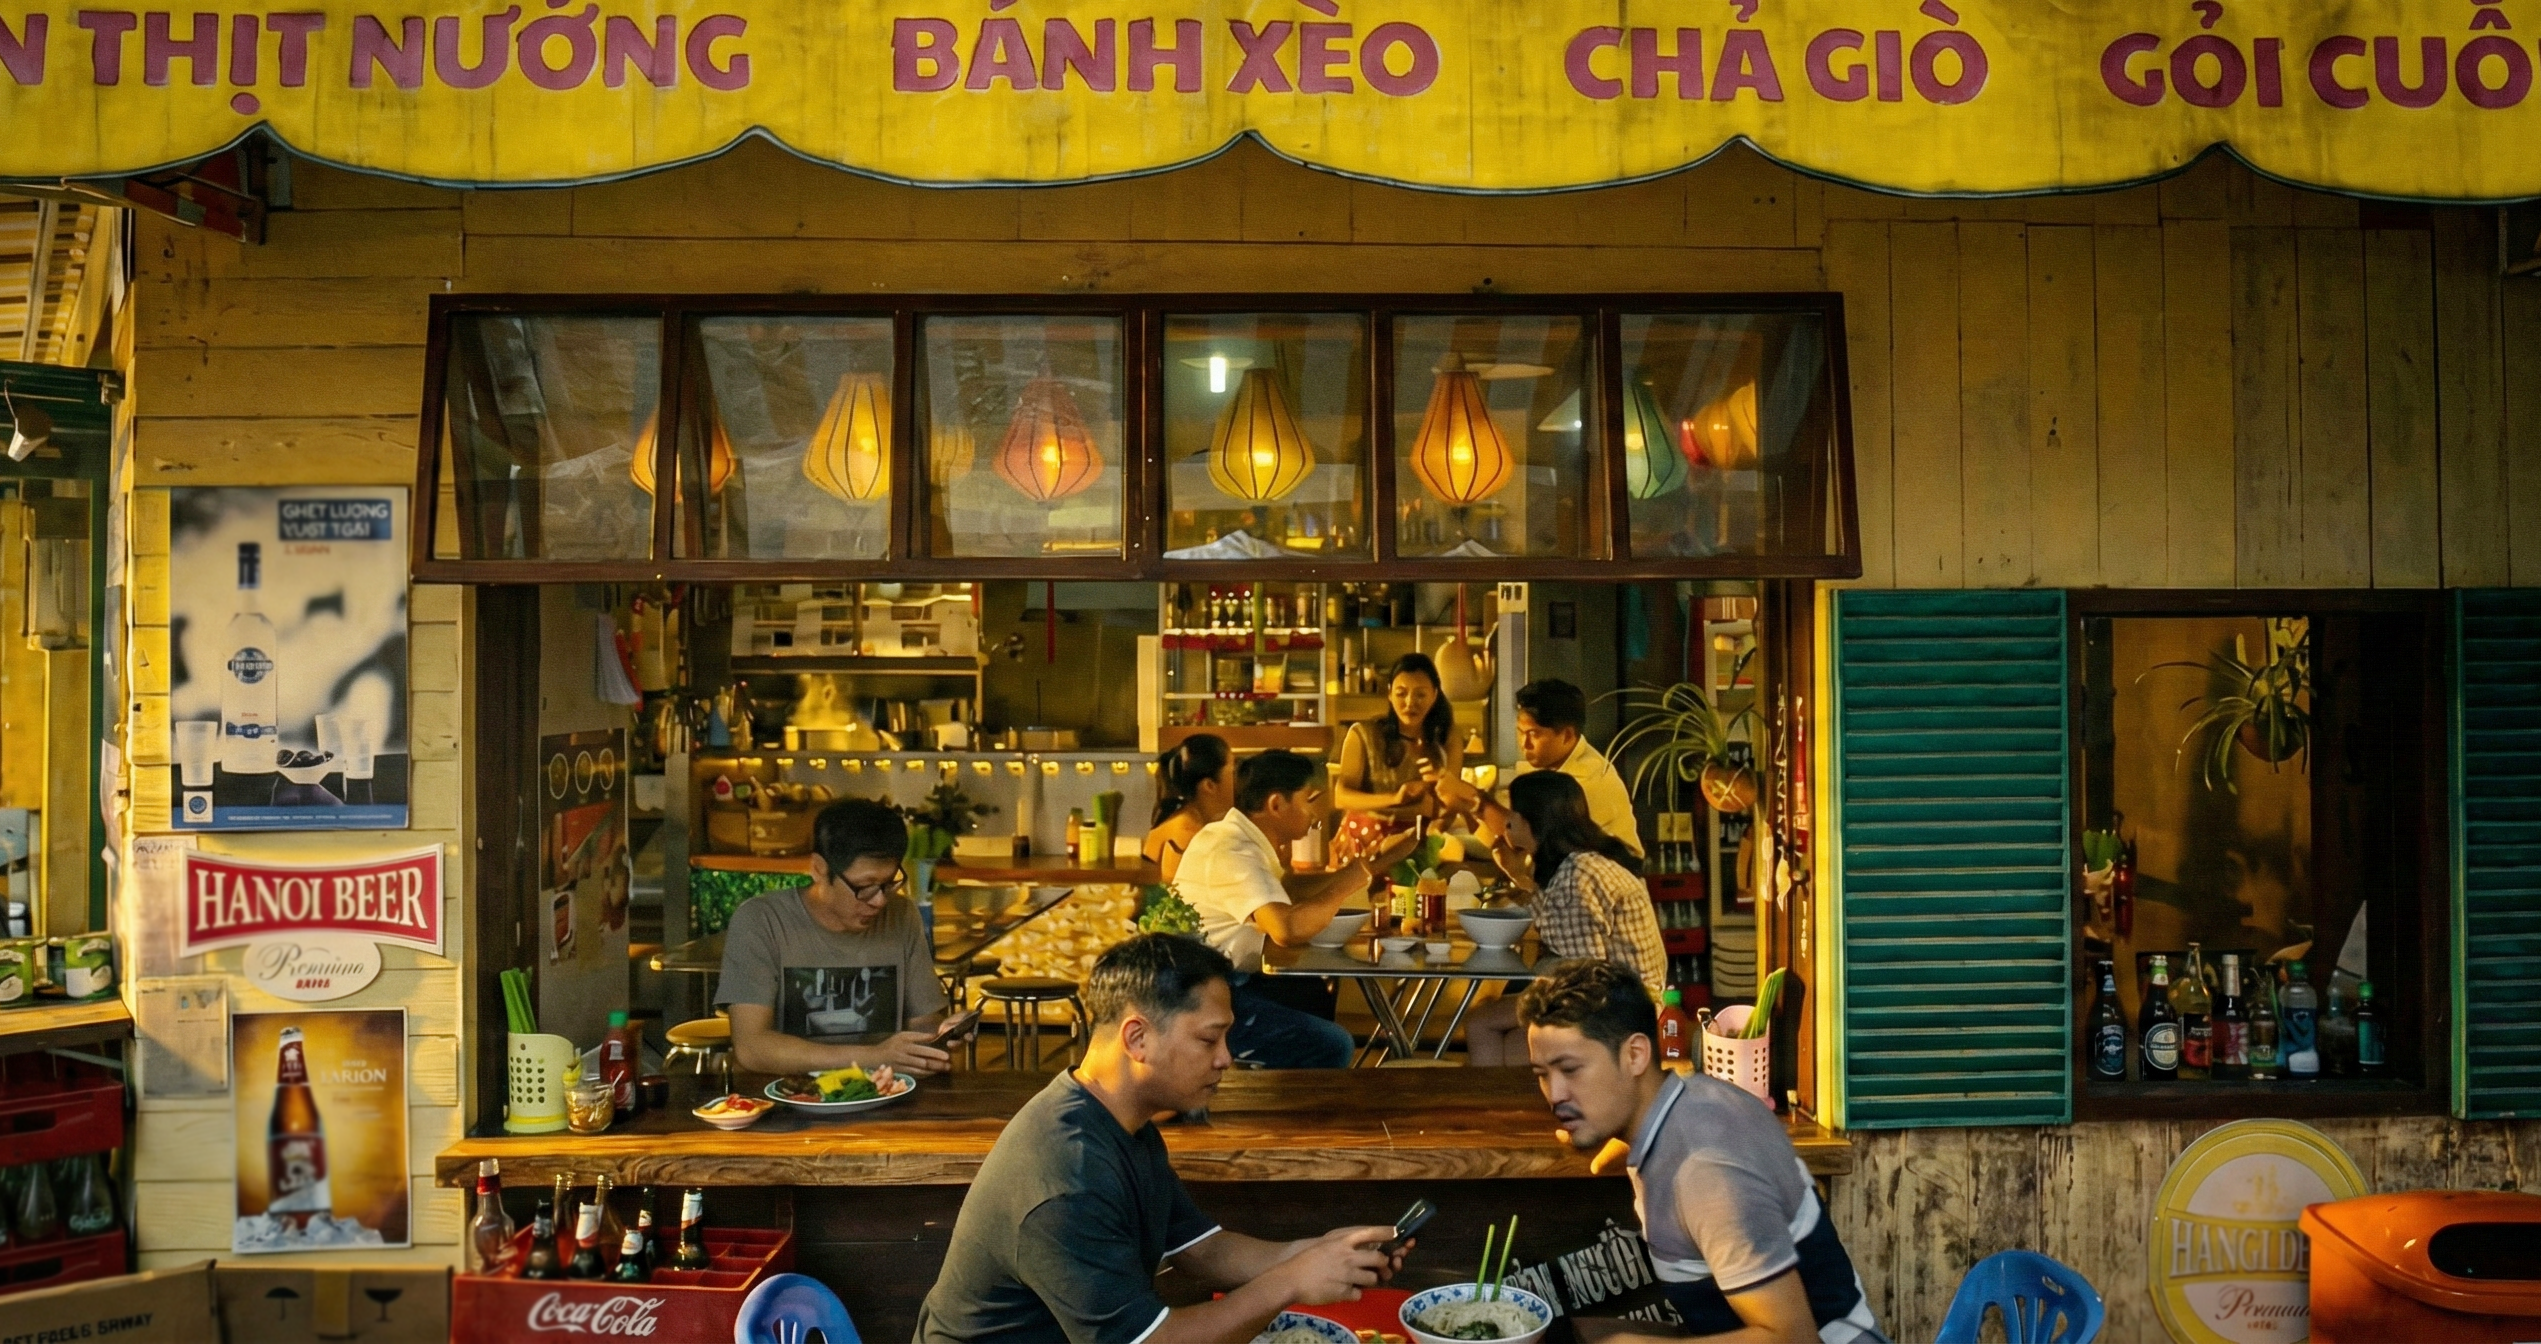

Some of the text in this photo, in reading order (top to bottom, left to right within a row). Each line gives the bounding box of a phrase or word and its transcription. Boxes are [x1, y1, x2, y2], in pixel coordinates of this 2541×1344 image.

[77, 12, 326, 116] THỊT
[1226, 0, 1440, 96] XÈO
[1564, 0, 1989, 105] CHẢ GIÒ
[2100, 0, 2284, 108] GỎI
[195, 866, 428, 931] HANOI BEER
[527, 1292, 666, 1337] Coca-Cola
